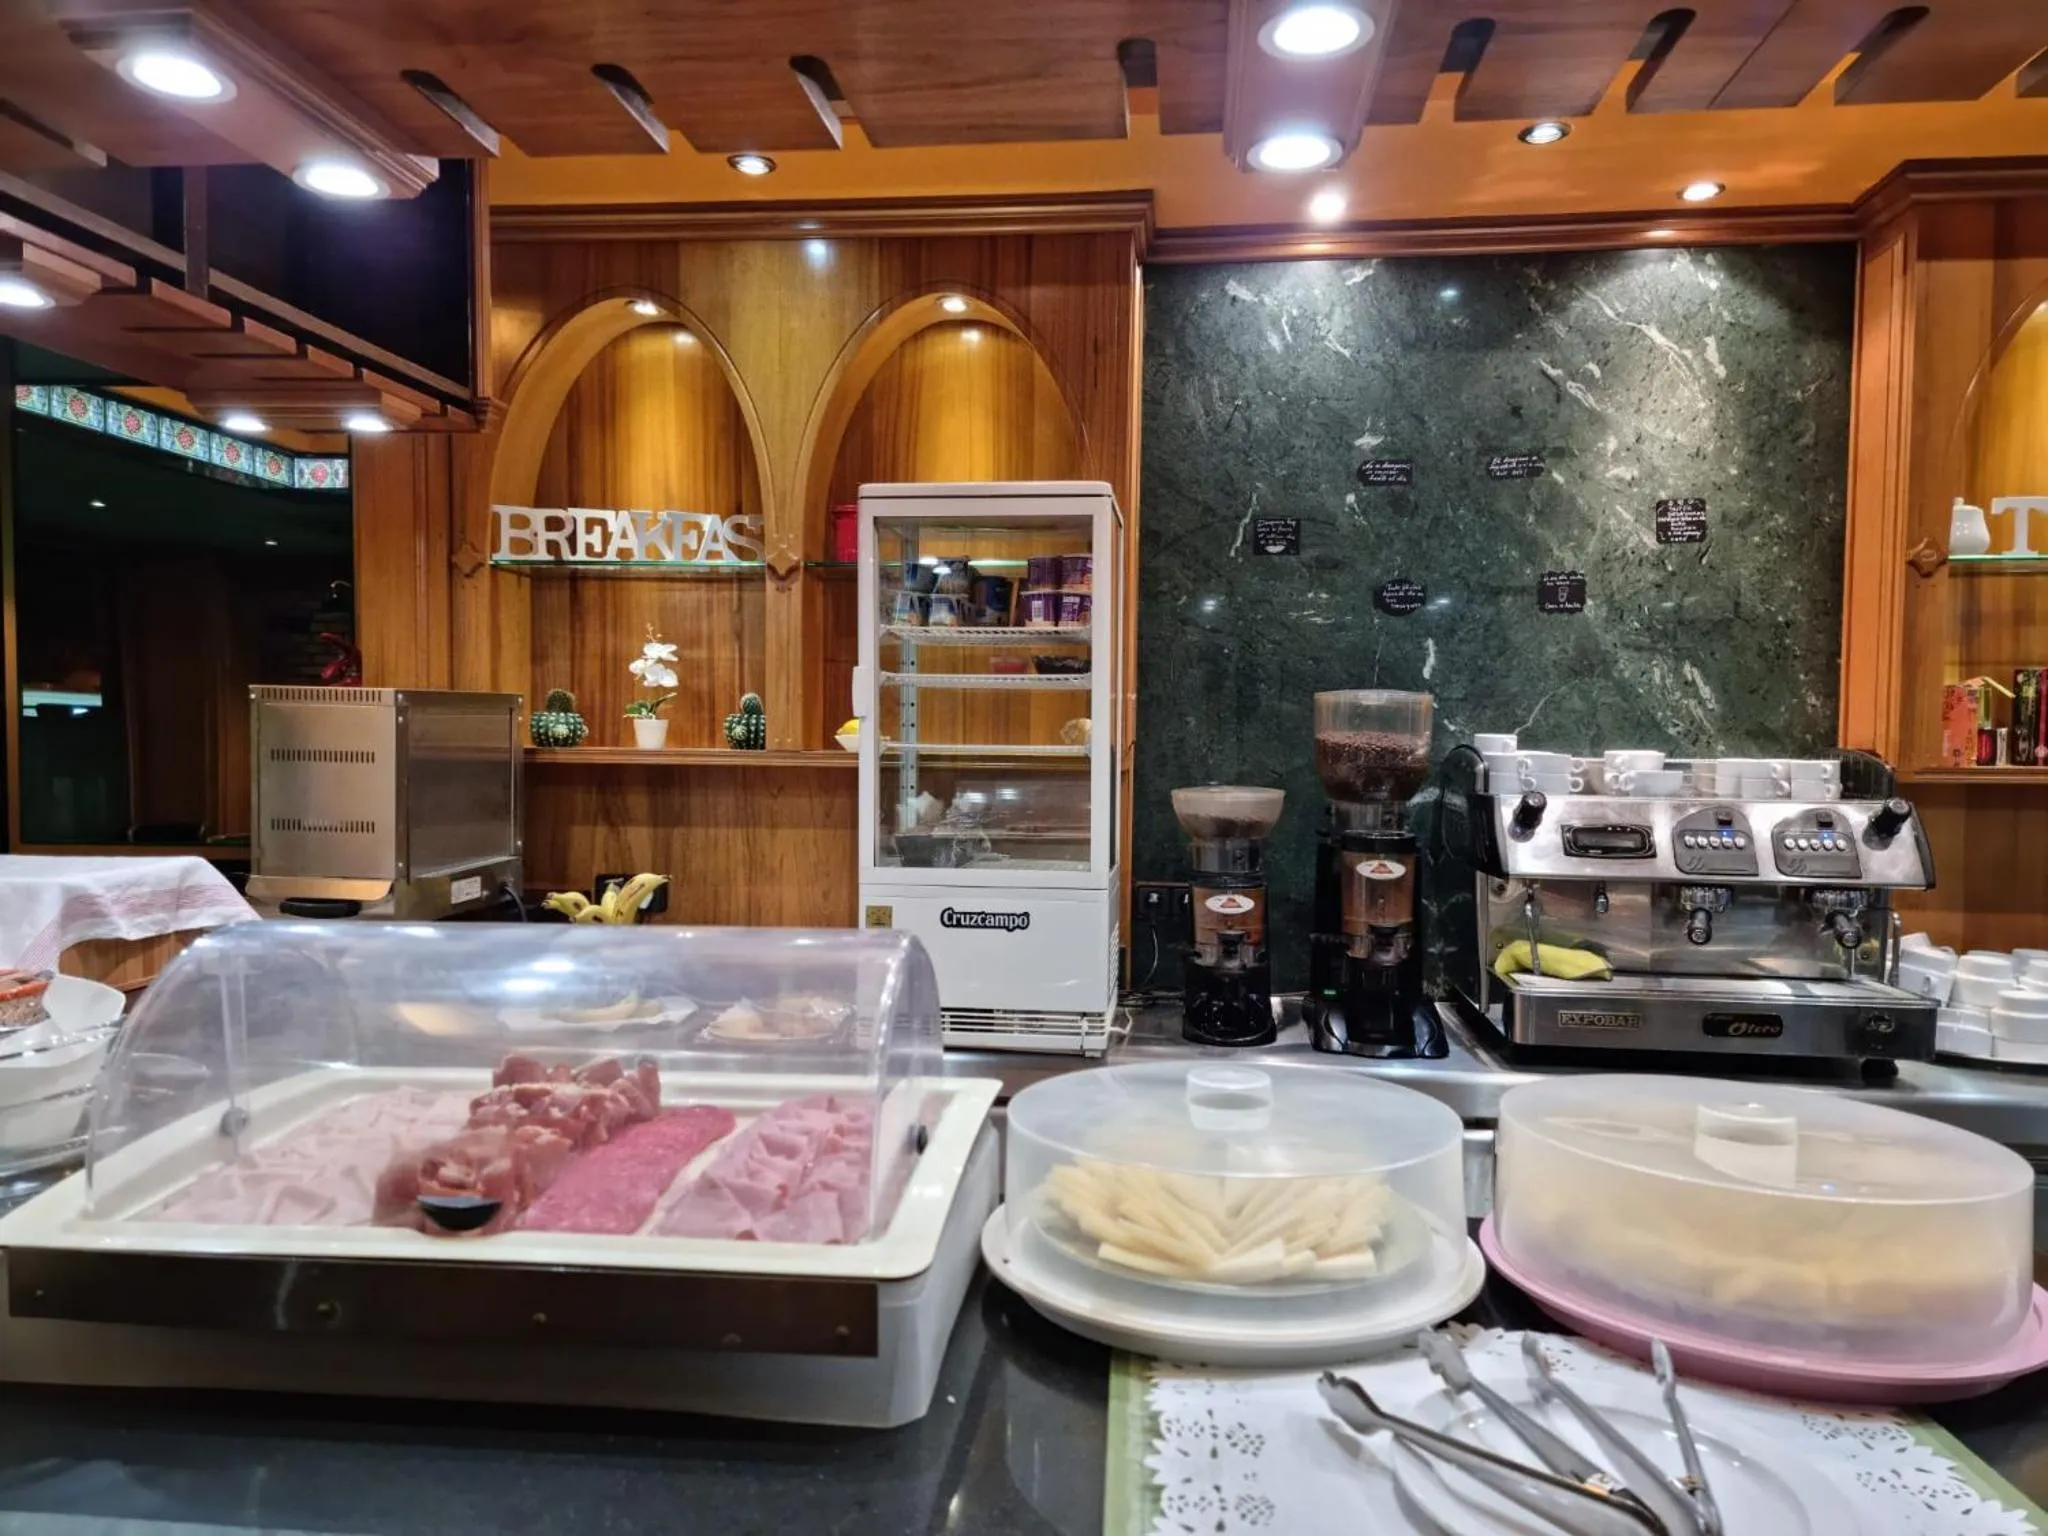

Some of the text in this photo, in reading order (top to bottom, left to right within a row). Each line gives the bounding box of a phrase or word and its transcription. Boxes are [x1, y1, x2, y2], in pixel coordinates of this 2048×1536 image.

[489, 504, 765, 561] BREAKFAS
[942, 908, 1030, 930] Cruzcampo
[1561, 1013, 1639, 1028] EXPOBAR
